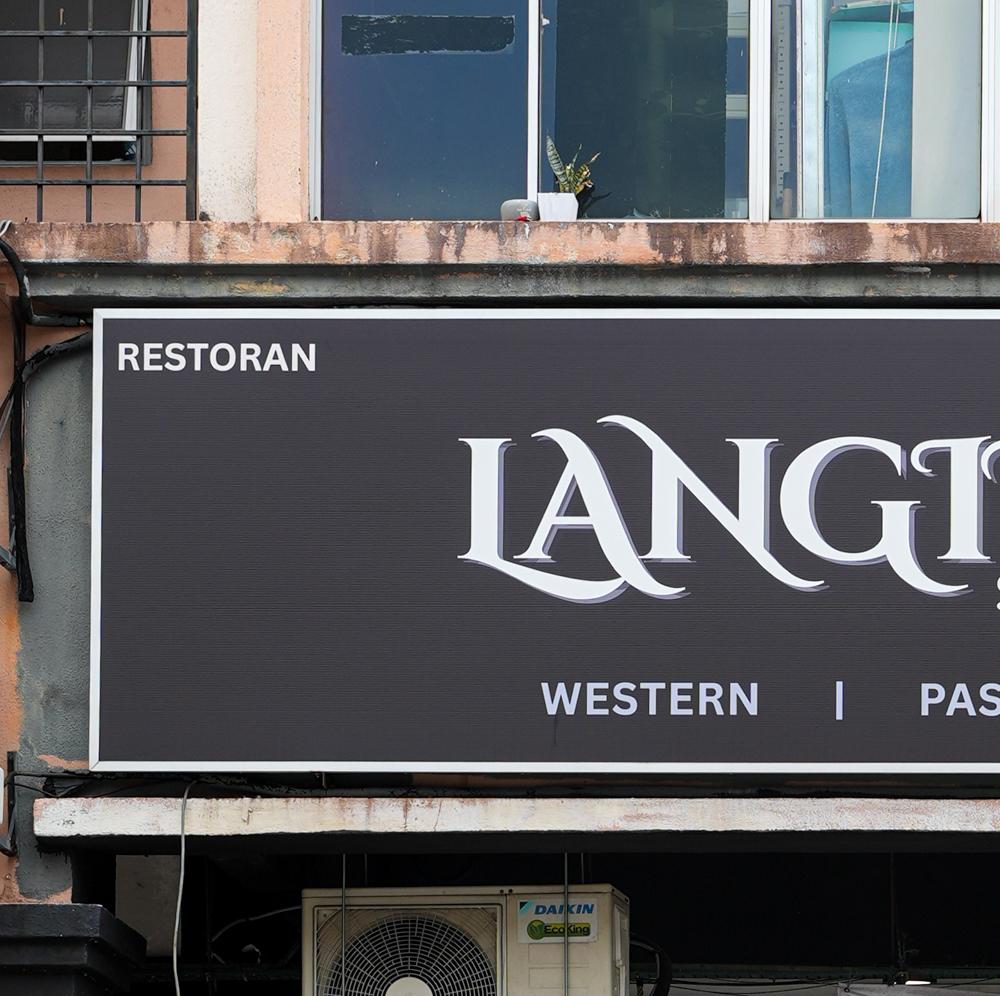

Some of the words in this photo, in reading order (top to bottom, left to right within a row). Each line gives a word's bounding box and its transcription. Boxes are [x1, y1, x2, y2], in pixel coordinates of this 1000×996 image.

[118, 342, 316, 372] RESTORAN
[541, 682, 758, 716] WESTERN
[534, 904, 594, 915] DAIKIN
[544, 925, 591, 936] EcoKing
